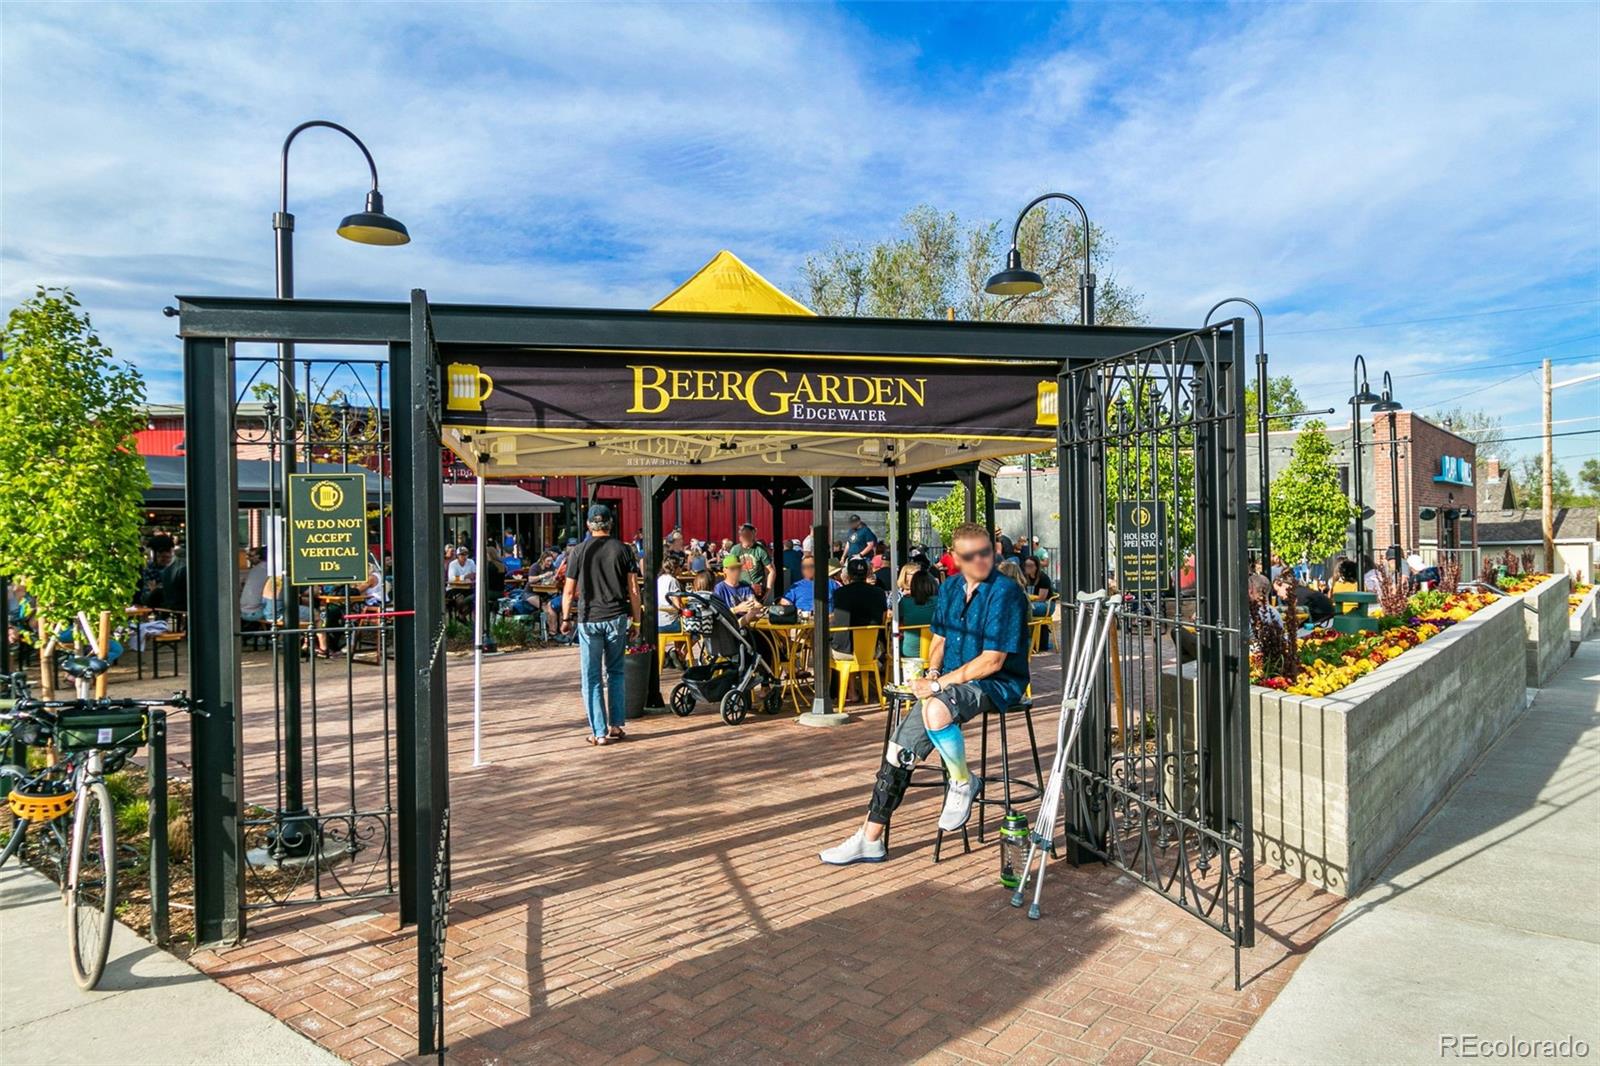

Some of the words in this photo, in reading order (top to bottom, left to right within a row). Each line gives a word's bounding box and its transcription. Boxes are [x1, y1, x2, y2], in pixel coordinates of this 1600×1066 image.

[626, 365, 927, 415] BEERGARDEN
[793, 403, 887, 422] EDGEWATER
[295, 520, 315, 529] WE
[317, 519, 335, 529] DO
[337, 518, 362, 528] NOT
[306, 533, 352, 543] ACCEPT
[301, 547, 358, 557] VERTICAL
[320, 561, 340, 571] ID's
